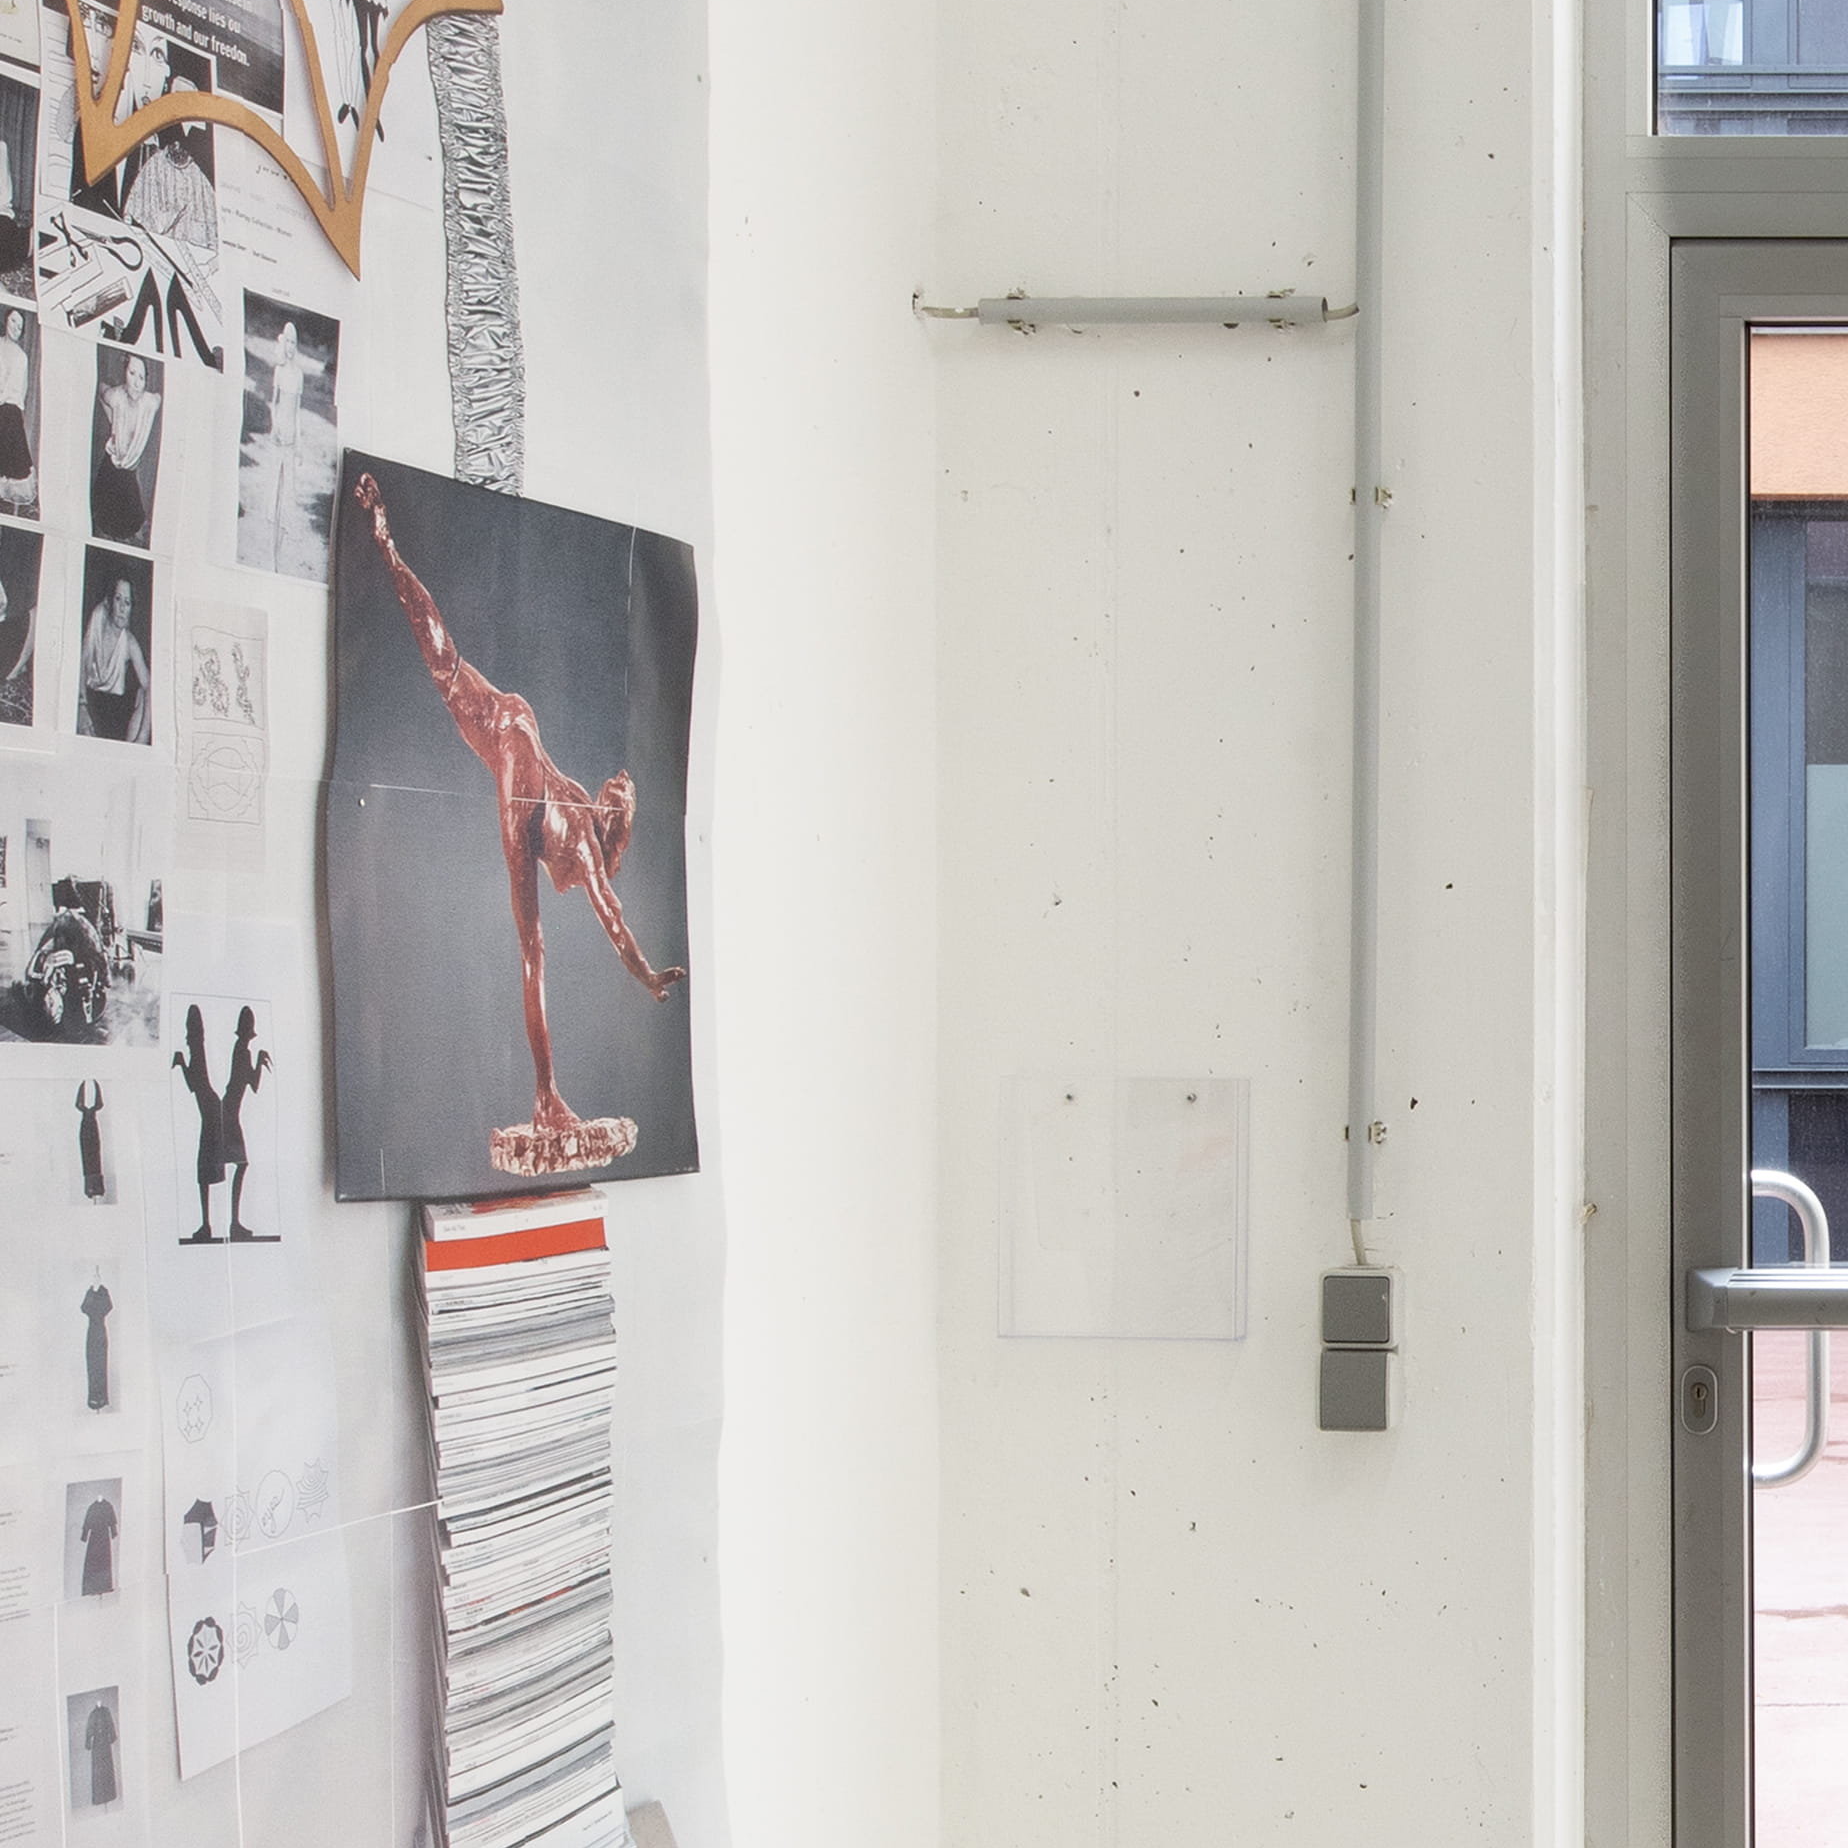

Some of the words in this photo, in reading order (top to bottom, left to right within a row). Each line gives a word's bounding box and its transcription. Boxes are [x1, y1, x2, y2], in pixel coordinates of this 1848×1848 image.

[141, 4, 176, 33] growth
[176, 18, 193, 39] and
[193, 29, 210, 49] our
